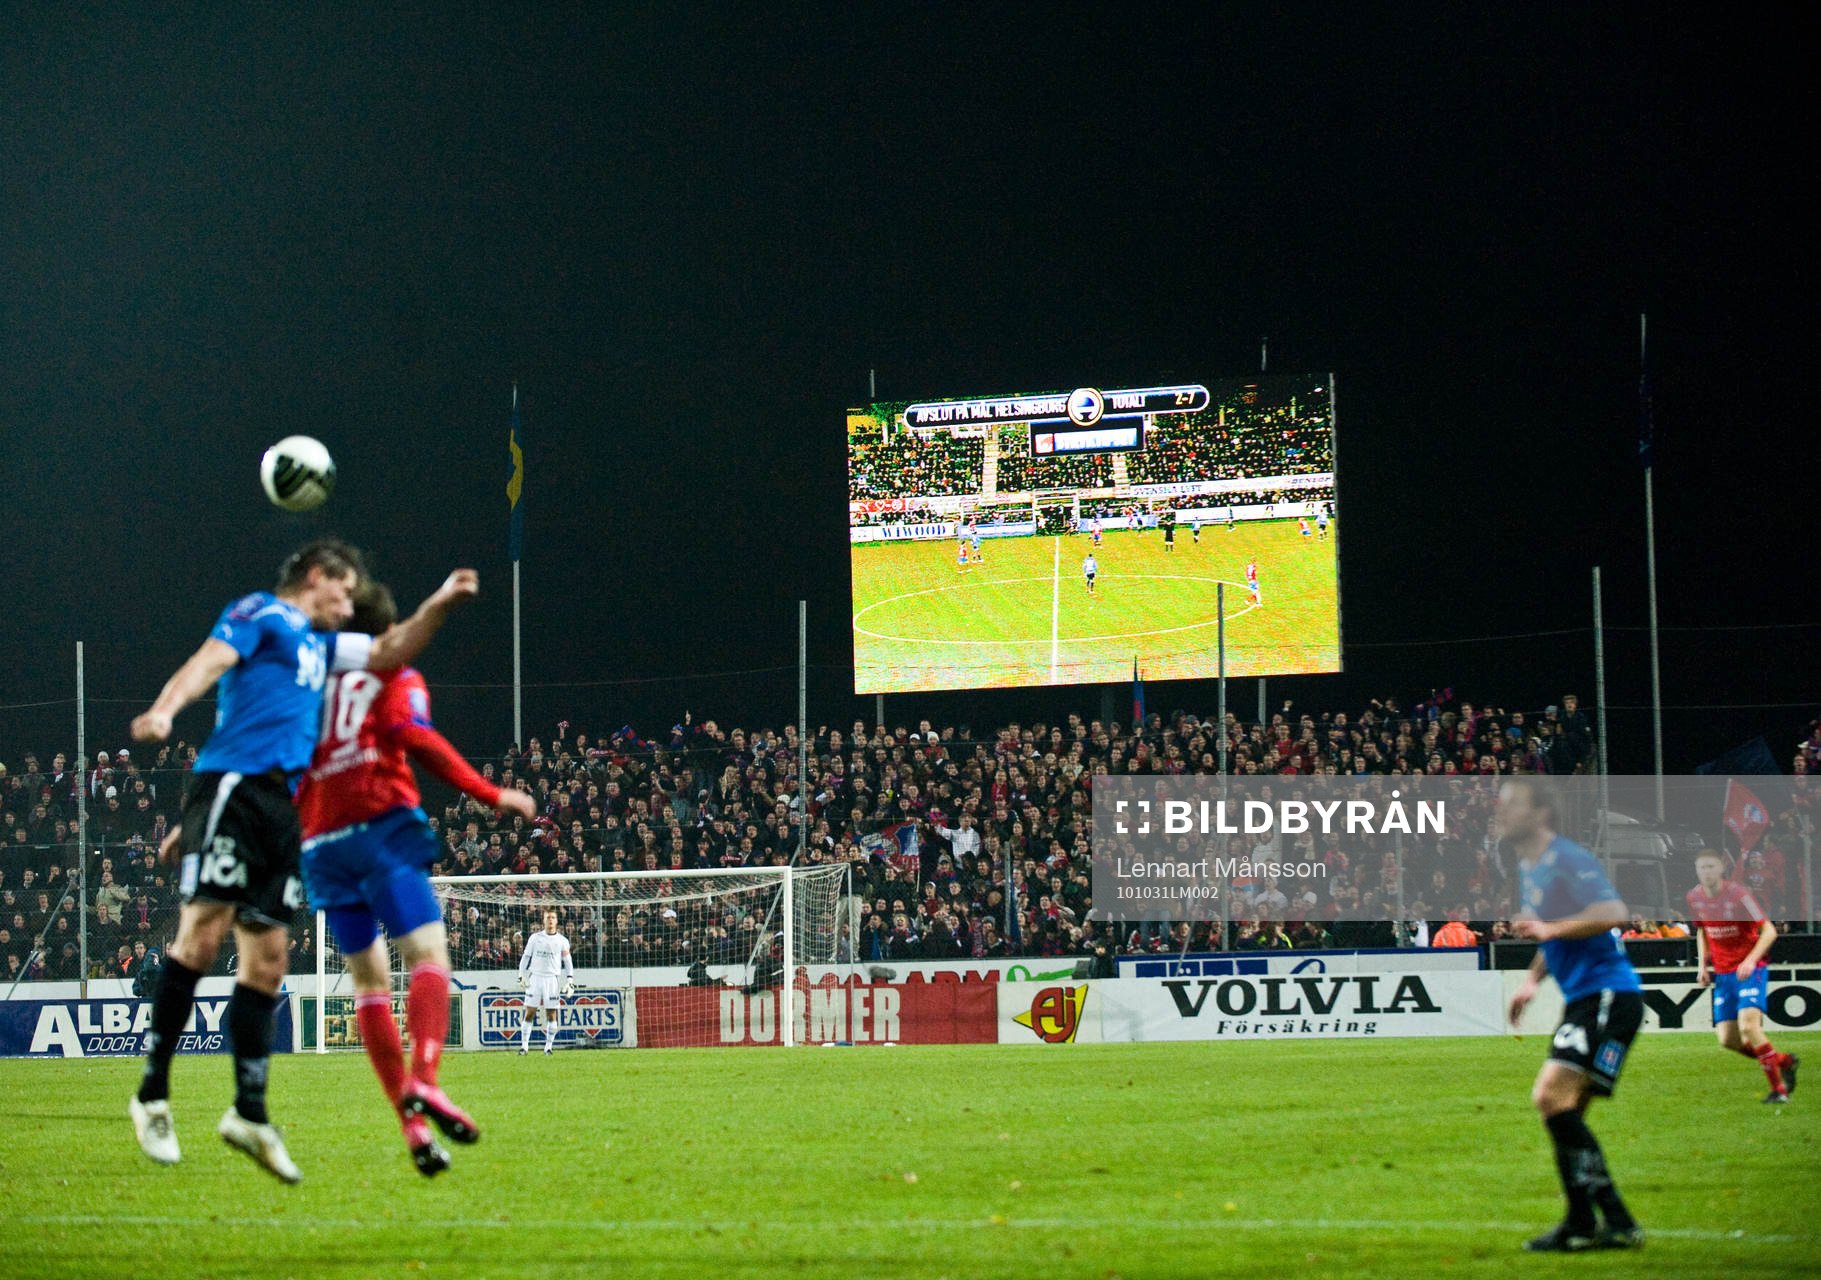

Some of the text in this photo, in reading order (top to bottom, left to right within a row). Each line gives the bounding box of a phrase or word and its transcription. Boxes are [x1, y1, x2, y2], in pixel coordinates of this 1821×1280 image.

[995, 400, 1066, 417] HELSINGBORG
[1112, 394, 1146, 409] TOTALT
[1162, 975, 1442, 1017] VOLVIA
[485, 1007, 616, 1028] THRE EARTS
[719, 987, 900, 1043] DORMER
[1217, 1019, 1378, 1035] Försäkring
[87, 1035, 223, 1052] DOOR STEMS
